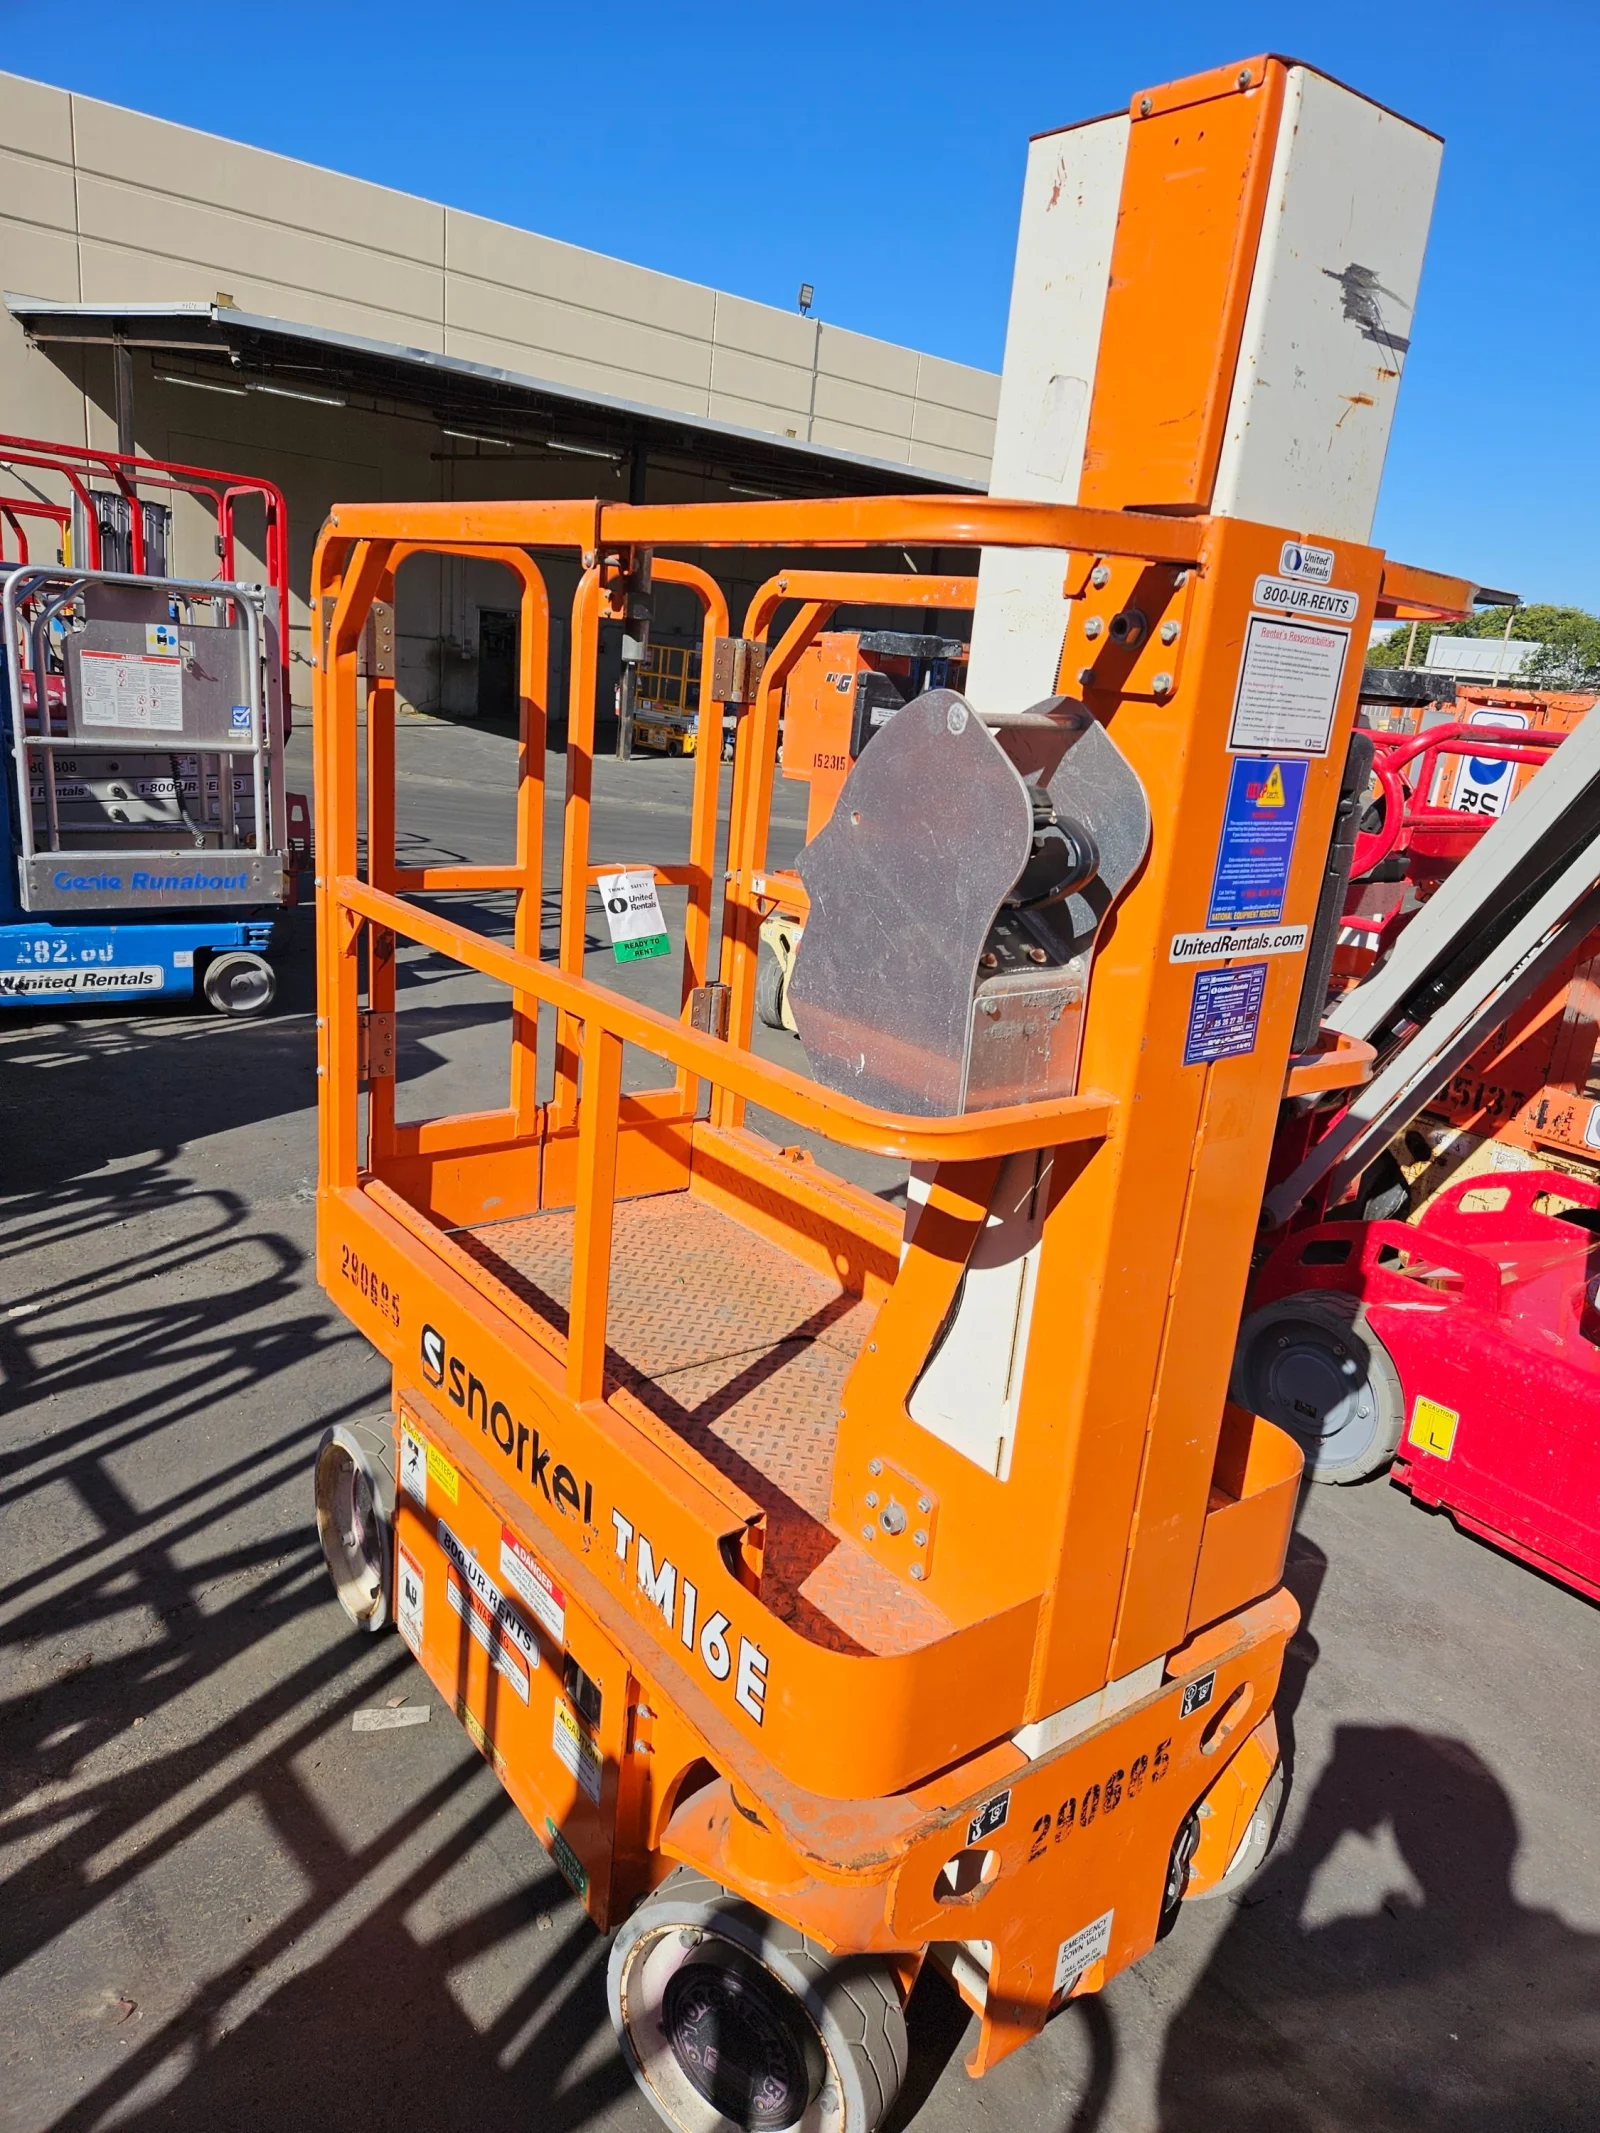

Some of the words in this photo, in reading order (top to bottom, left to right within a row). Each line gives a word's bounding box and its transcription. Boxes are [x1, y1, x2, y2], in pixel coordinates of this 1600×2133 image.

[1304, 551, 1331, 566] United
[1302, 562, 1329, 578] Rentals
[1262, 585, 1350, 615] 800-UR-RENTS
[1260, 627, 1288, 641] Renter's
[813, 752, 846, 772] 152315
[38, 786, 84, 797] Rntals
[53, 870, 122, 892] Genie
[131, 870, 249, 892] Runabout
[628, 892, 654, 904] United
[630, 901, 657, 912] Rentals
[624, 940, 649, 950] READY
[634, 948, 655, 957] RENT
[1172, 932, 1304, 957] UnitedRentals.com
[82, 971, 154, 988] Rentals
[1428, 1404, 1454, 1420] CAUTION
[448, 1356, 594, 1524] snorkel
[430, 1450, 456, 1482] BATTERY
[518, 1549, 554, 1594] DANGER
[443, 1532, 533, 1653] 800-UR-RENTS
[611, 1506, 770, 1727] TM16E
[565, 1718, 598, 1765] CAUTION
[1060, 1943, 1084, 1964] DOWN
[1086, 1926, 1107, 1947] VALVE
[1062, 1916, 1109, 1953] EMERGENCY
[1064, 1962, 1076, 1974] PULL
[1091, 1947, 1098, 1956] TO
